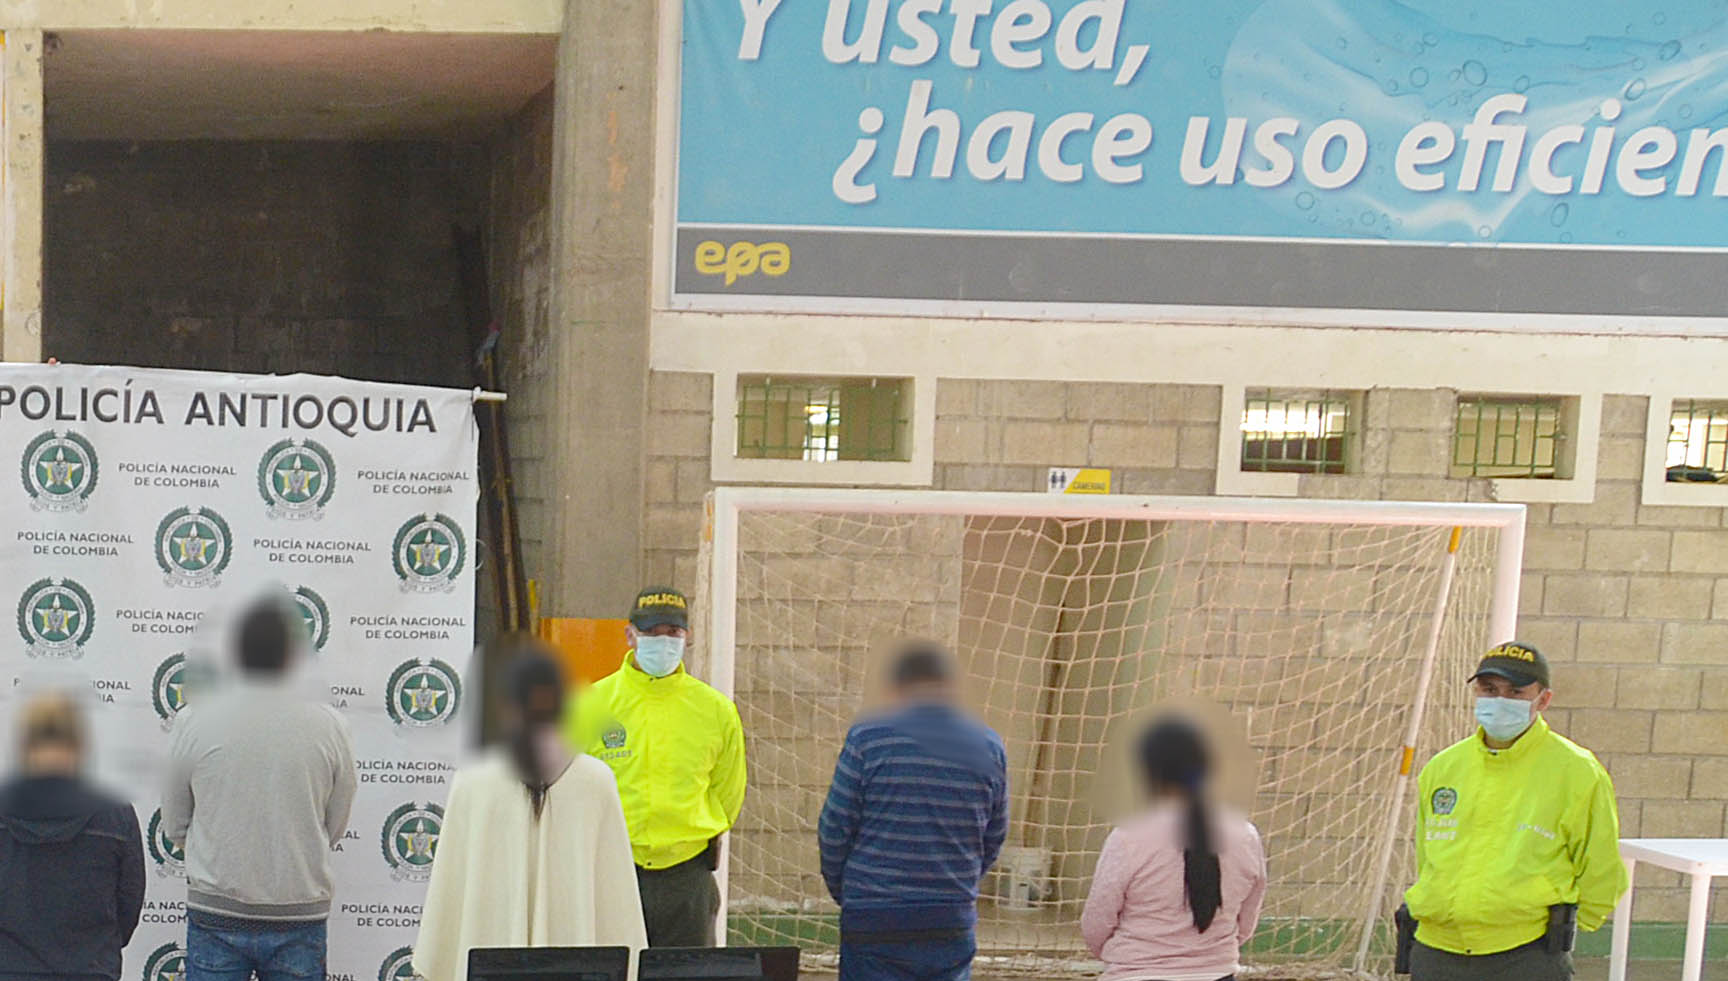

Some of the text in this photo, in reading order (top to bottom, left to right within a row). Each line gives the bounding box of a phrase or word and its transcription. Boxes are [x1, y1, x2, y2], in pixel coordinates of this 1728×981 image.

[737, 0, 1151, 85] Y usted,
[832, 79, 1152, 203] ¿hace
[1179, 115, 1370, 190] uso
[185, 392, 436, 440] ANTIOQUIA
[119, 463, 236, 475] POLICÍA NACIONAL
[358, 471, 469, 481] POLICÍA NACIONAL
[134, 477, 219, 488] DE COLOMBIA
[373, 485, 389, 493] DE
[17, 532, 133, 543] POLICÍA NACIONAL
[254, 539, 371, 551] POLICÍA NACIONAL
[33, 545, 118, 556] DE COLOMBIA
[269, 553, 354, 564] DE COLOMBIA
[639, 594, 686, 608] POLICIA
[116, 610, 204, 620] POLICÍA NACIO
[350, 617, 465, 626] POLICÍA NACIONAL
[132, 624, 196, 633] DE COLOM
[366, 630, 449, 639] DE COLOMBIA
[361, 774, 445, 784] DE COLOMBIA
[342, 904, 389, 913] POLICÍA
[142, 914, 186, 923] COLOM
[357, 918, 421, 927] DE COLOM
